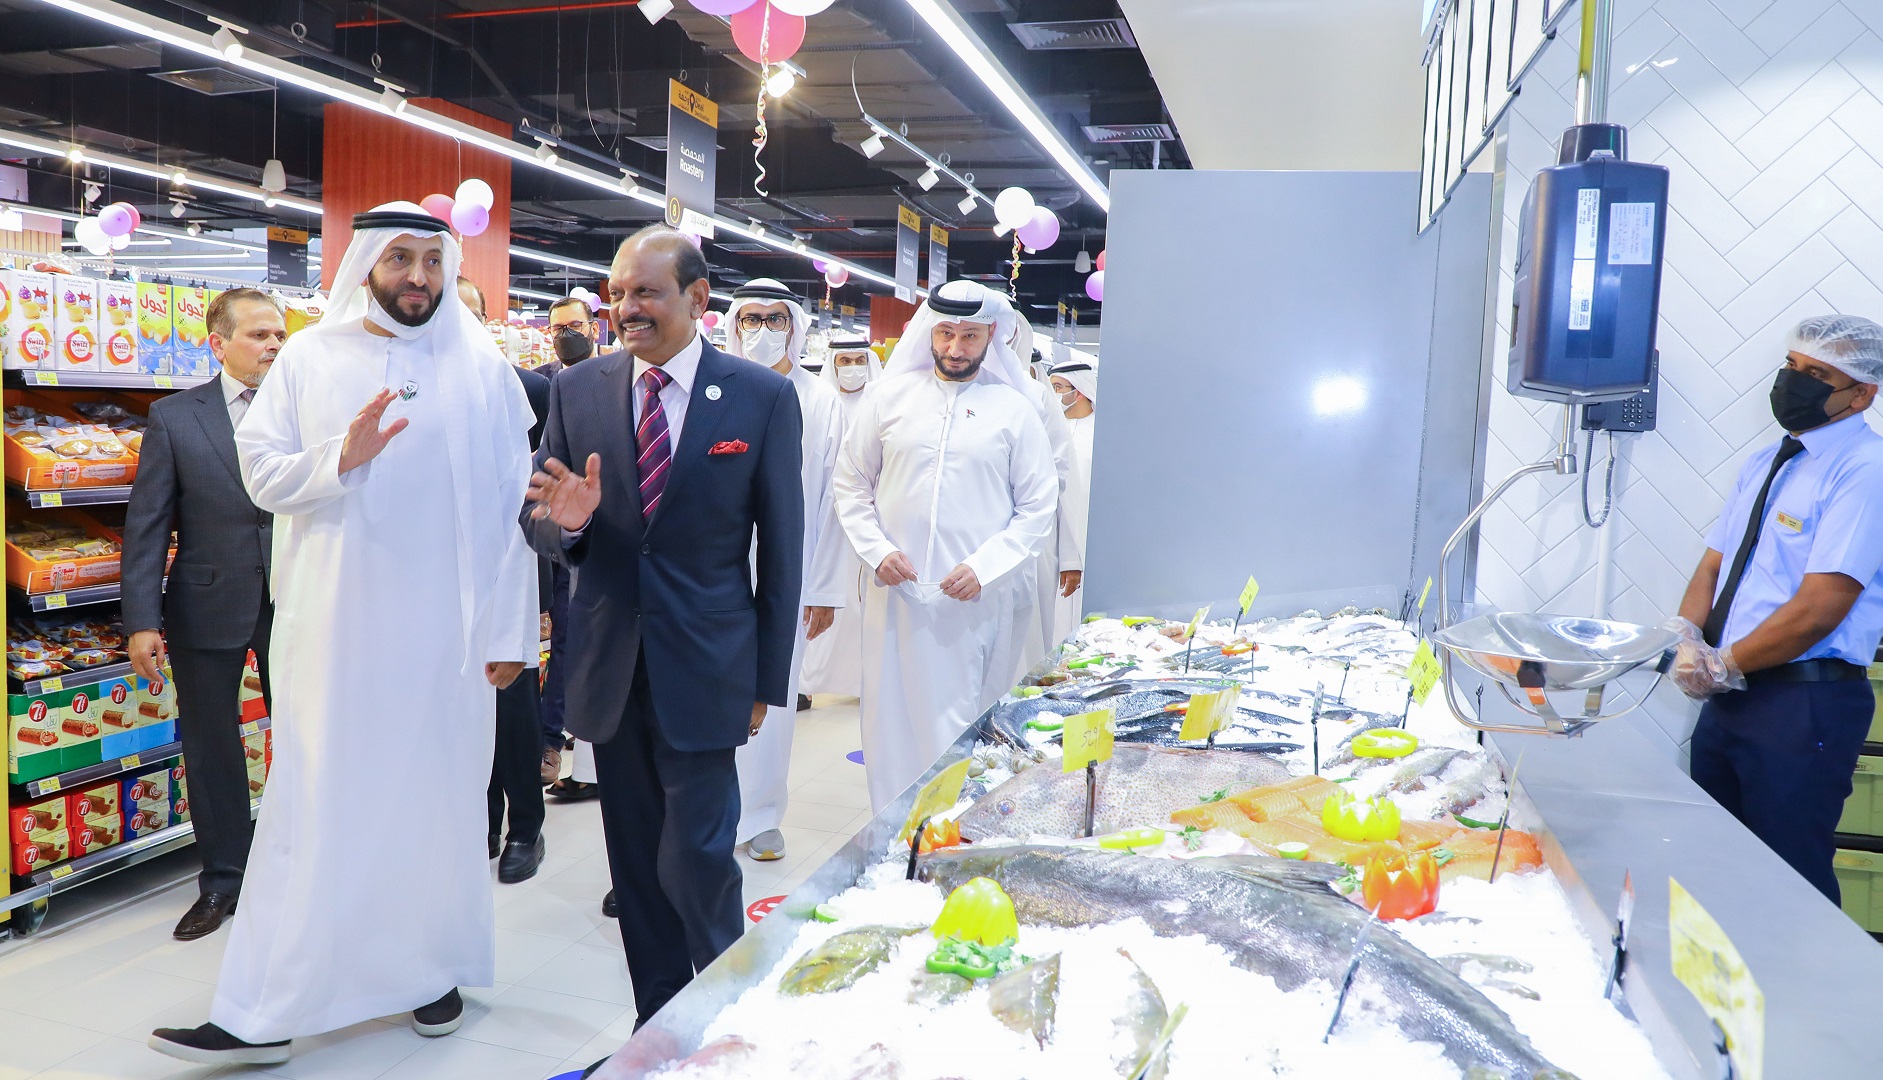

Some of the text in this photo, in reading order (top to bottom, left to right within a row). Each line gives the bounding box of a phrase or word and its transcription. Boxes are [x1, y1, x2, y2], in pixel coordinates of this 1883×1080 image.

[679, 157, 705, 182] Roastery
[27, 337, 44, 346] Switz
[72, 340, 88, 348] Switz
[113, 342, 129, 350] Switz
